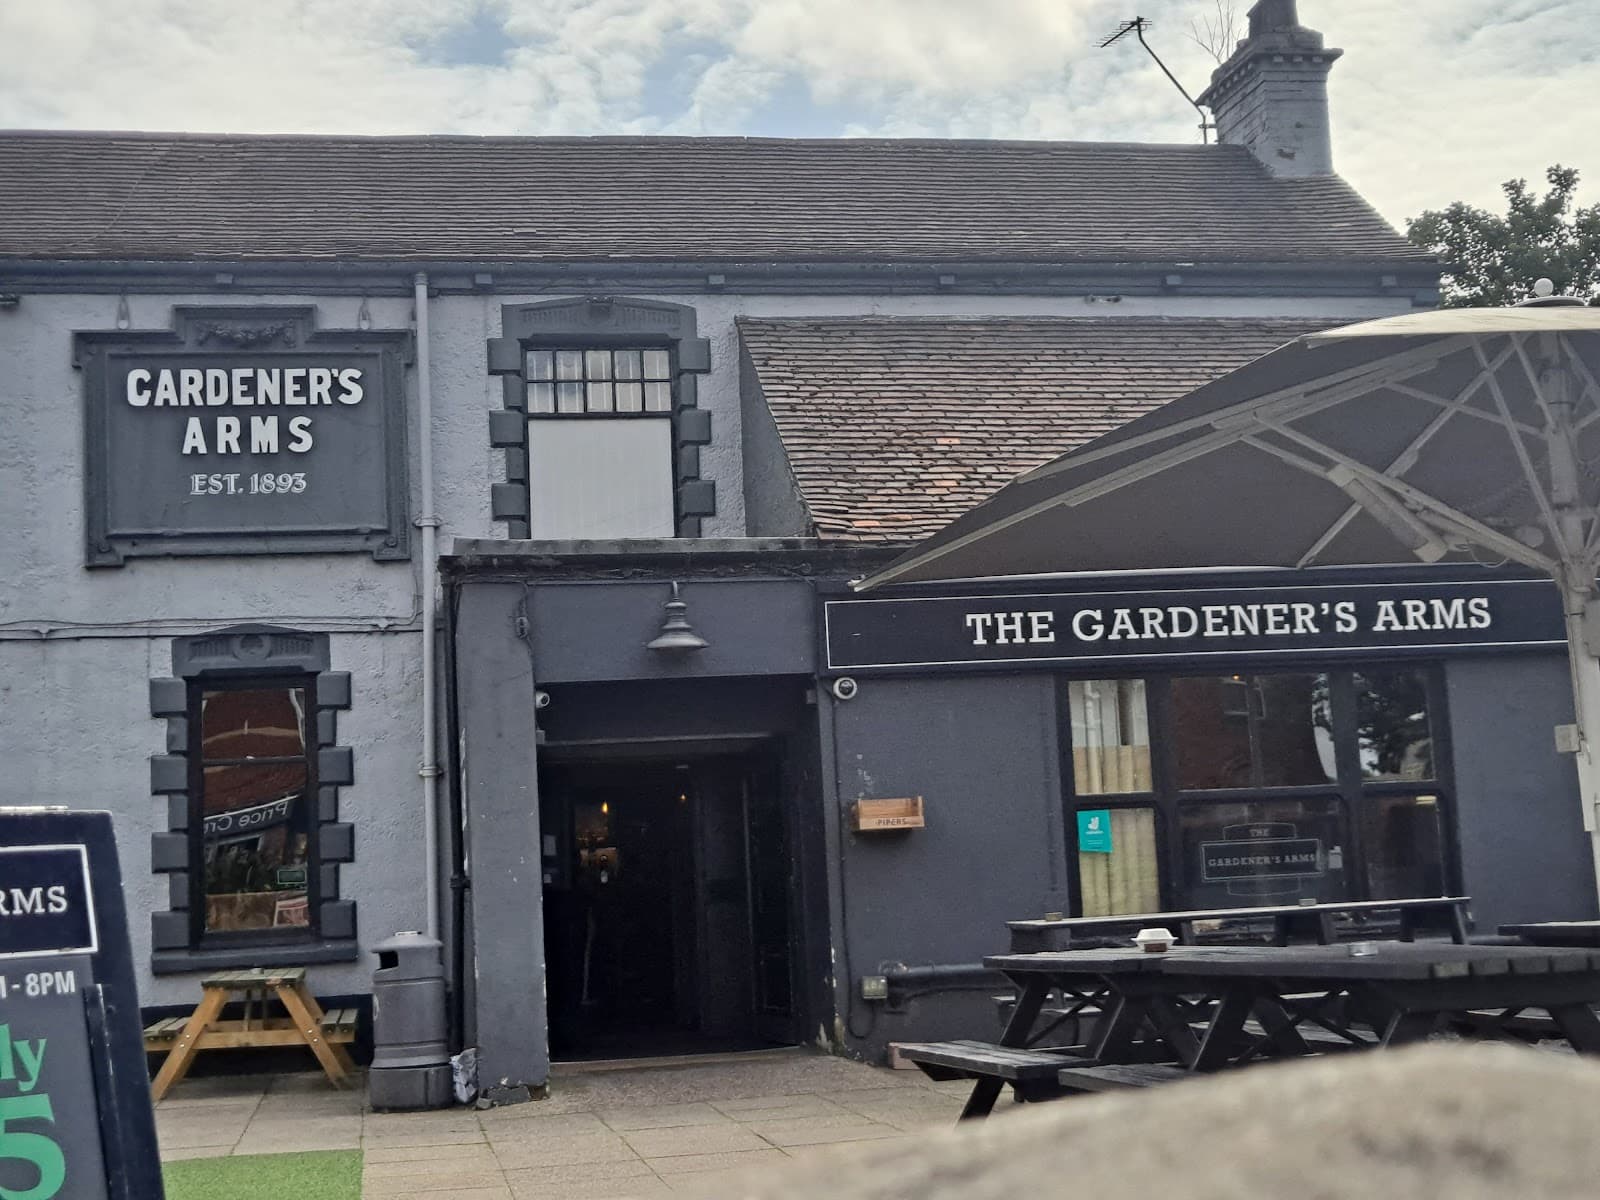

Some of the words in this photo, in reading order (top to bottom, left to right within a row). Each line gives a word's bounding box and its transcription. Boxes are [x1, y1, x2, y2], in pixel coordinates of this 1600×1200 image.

[127, 368, 364, 407] GARDENER'S
[182, 415, 314, 455] ARMS
[190, 473, 245, 496] EST.
[249, 472, 308, 495] 1893
[966, 610, 1056, 646] THE
[1072, 601, 1359, 642] GARDENER'S
[1372, 597, 1492, 633] ARMS
[1249, 828, 1270, 837] THE
[1208, 855, 1281, 867] GARDENER'S
[1284, 853, 1316, 864] ARMS
[25, 970, 76, 997] 8PM
